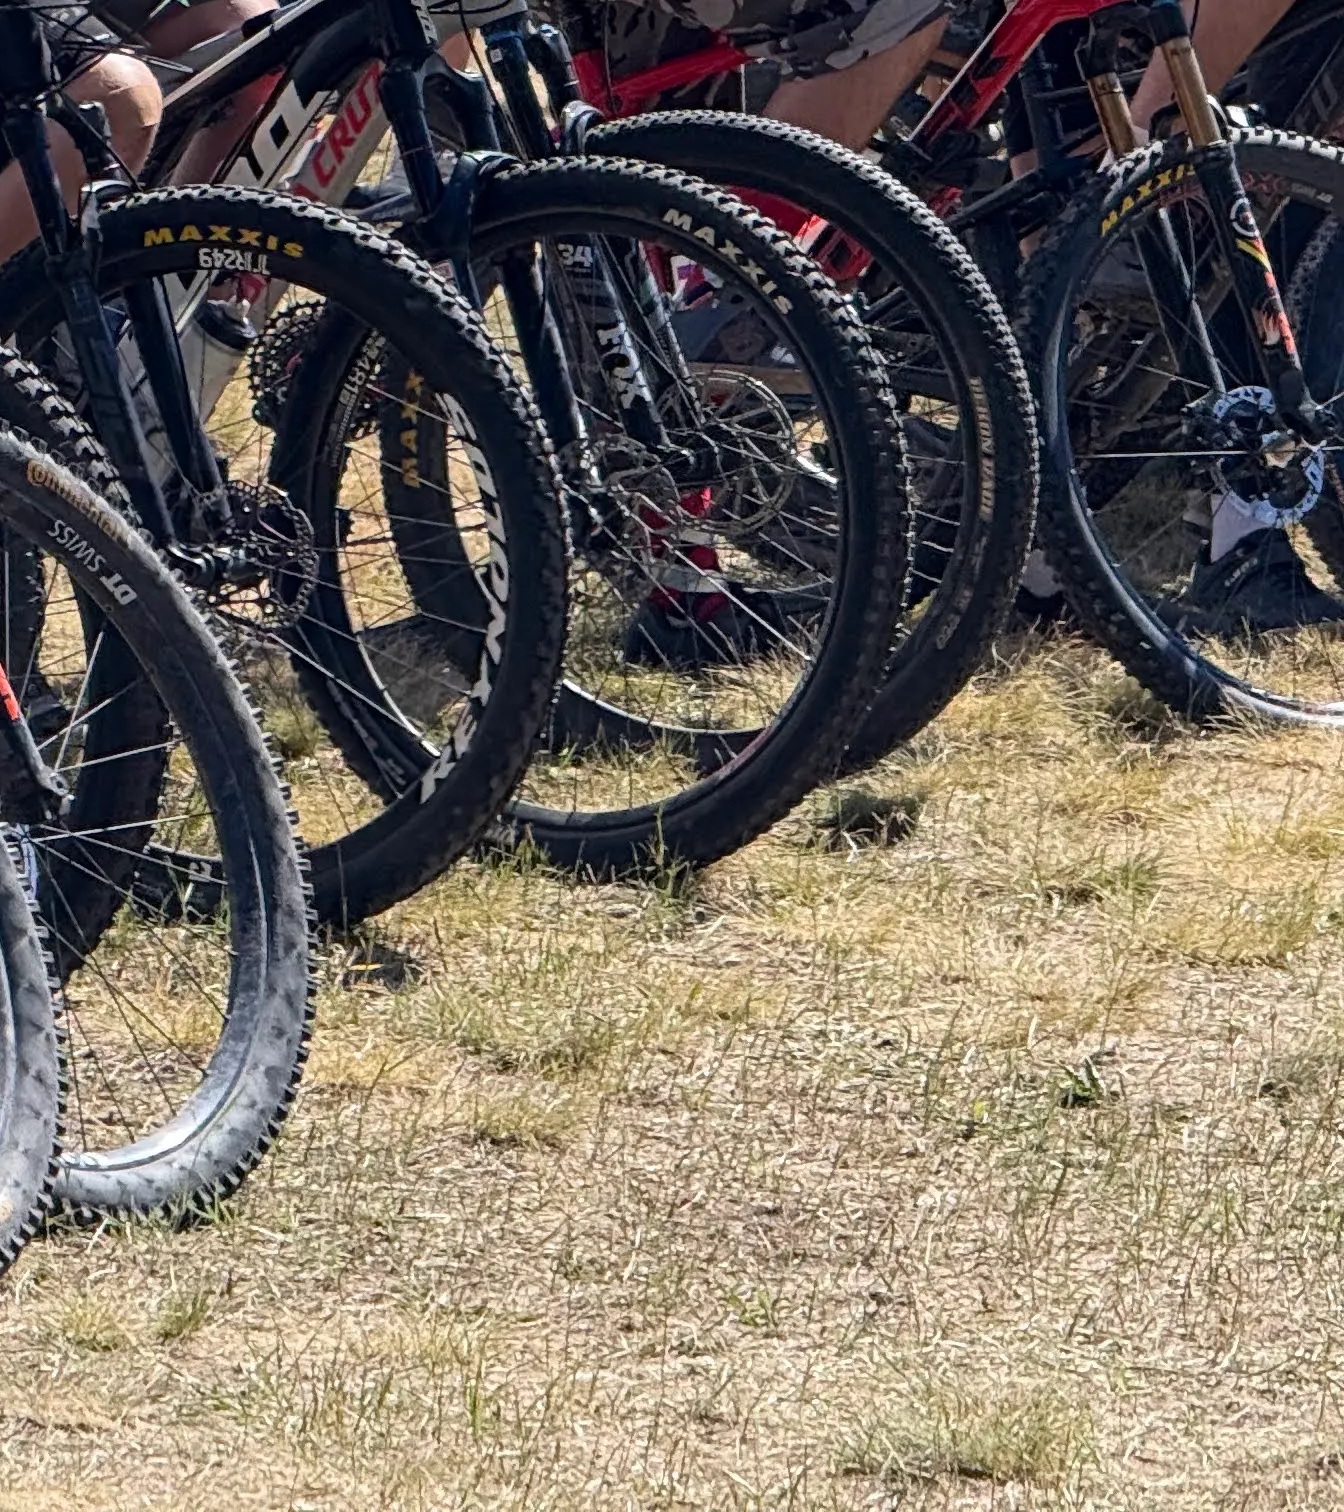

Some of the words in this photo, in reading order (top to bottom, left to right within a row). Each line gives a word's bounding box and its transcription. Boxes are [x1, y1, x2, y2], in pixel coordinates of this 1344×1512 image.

[142, 224, 304, 258] MAXXIS
[559, 243, 594, 268] 34
[663, 208, 792, 315] MAXXIS
[45, 518, 108, 573] SWISS
[97, 568, 137, 606] DT
[419, 391, 509, 804] REYNOLDS
